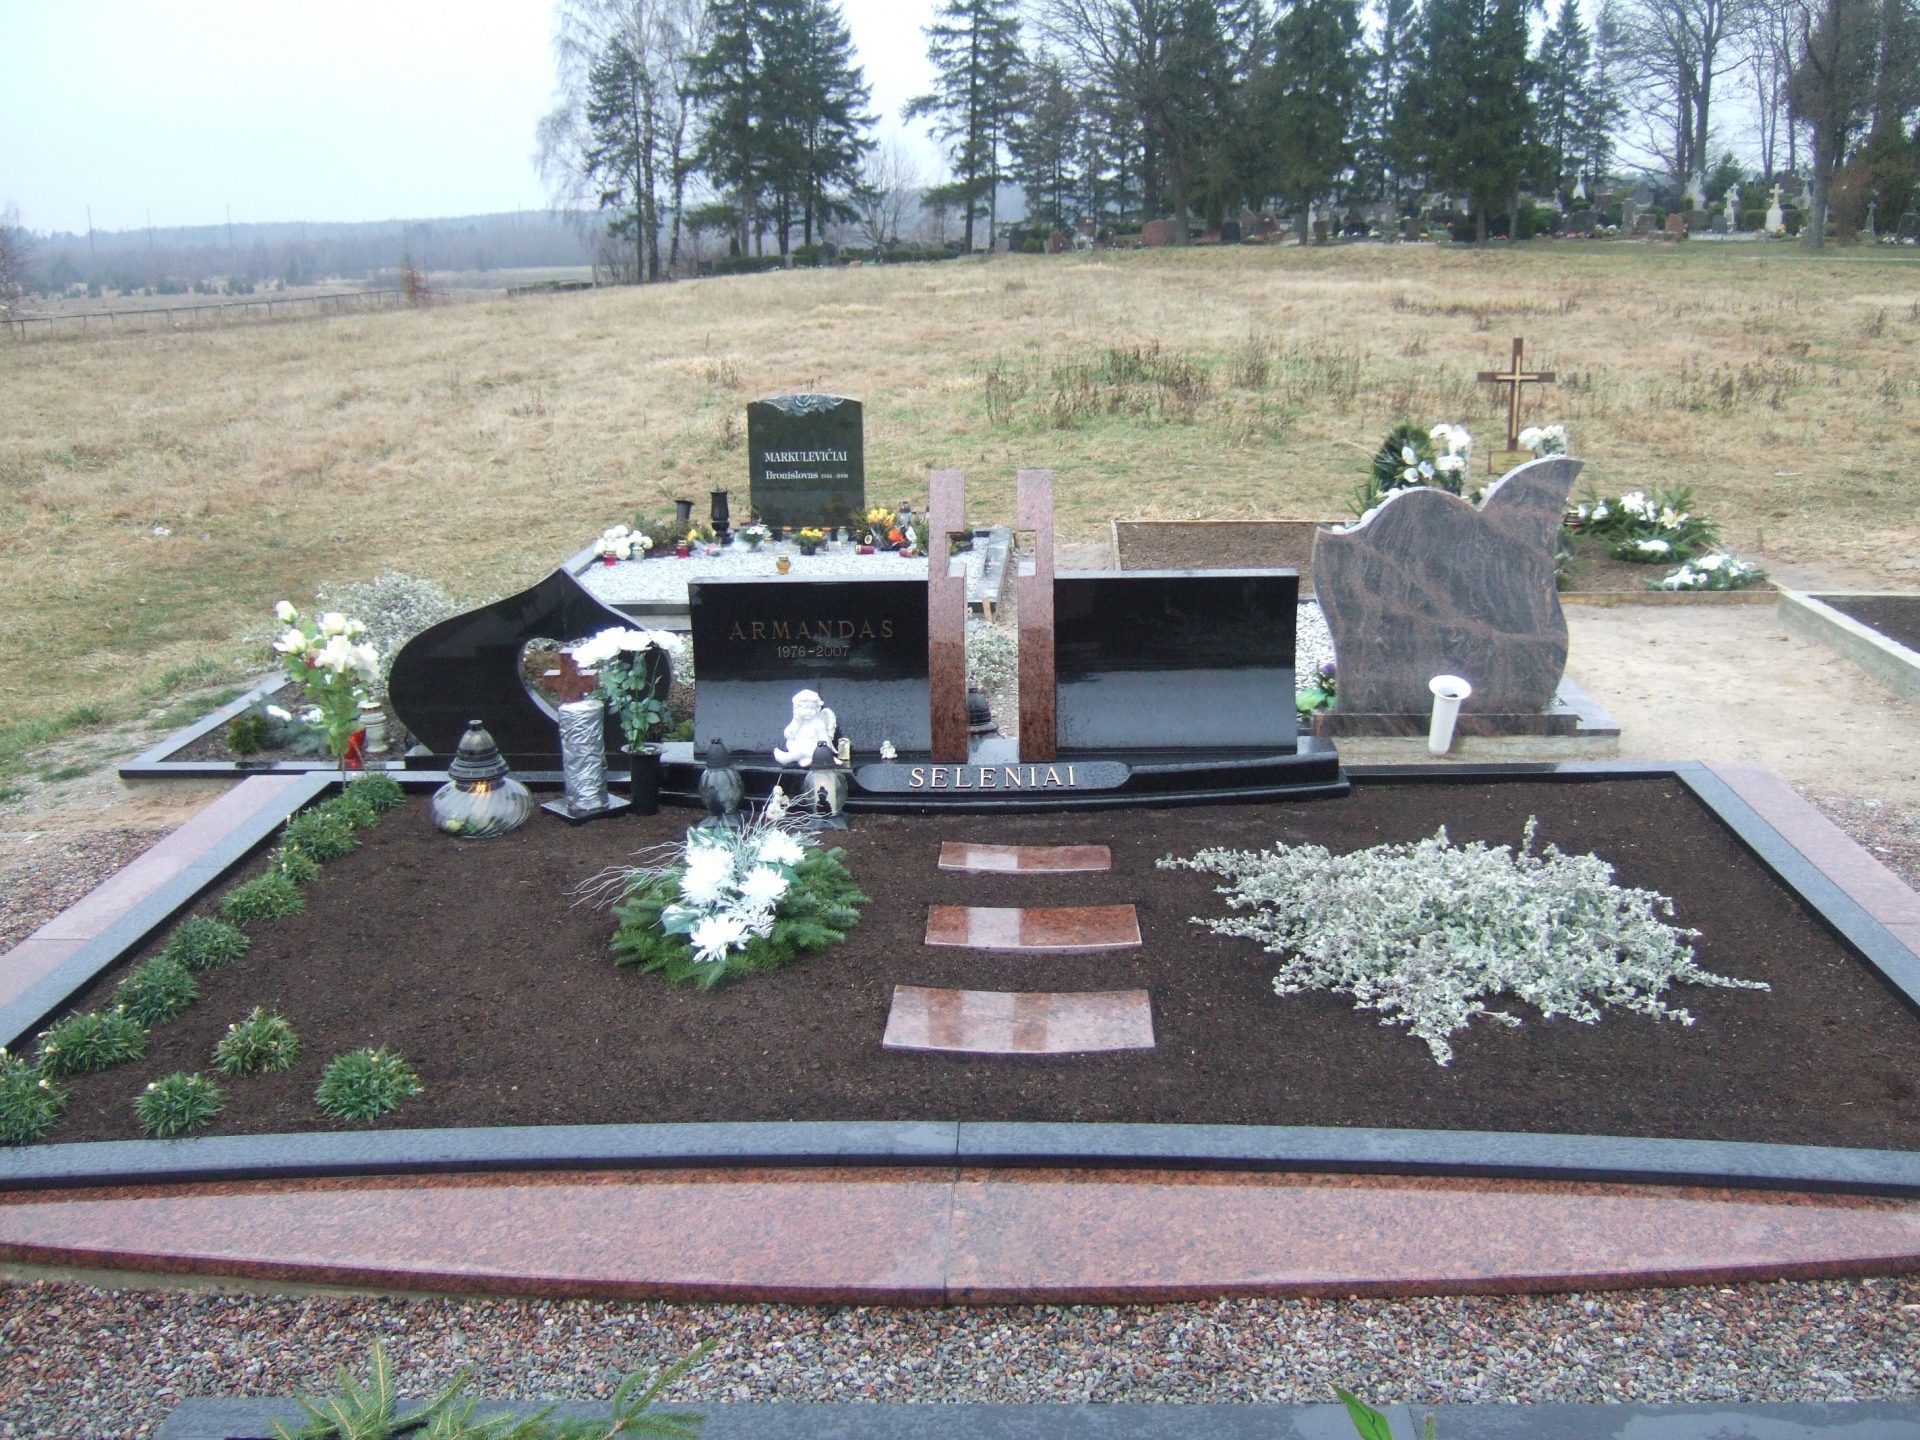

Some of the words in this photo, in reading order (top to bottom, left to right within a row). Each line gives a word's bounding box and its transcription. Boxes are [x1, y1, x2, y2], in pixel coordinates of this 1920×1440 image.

[765, 448, 848, 462] MARKULEVIČIAI
[765, 470, 819, 480] Bronislovas
[728, 619, 894, 640] ARMANDAS
[908, 765, 1077, 789] SELENIAI
